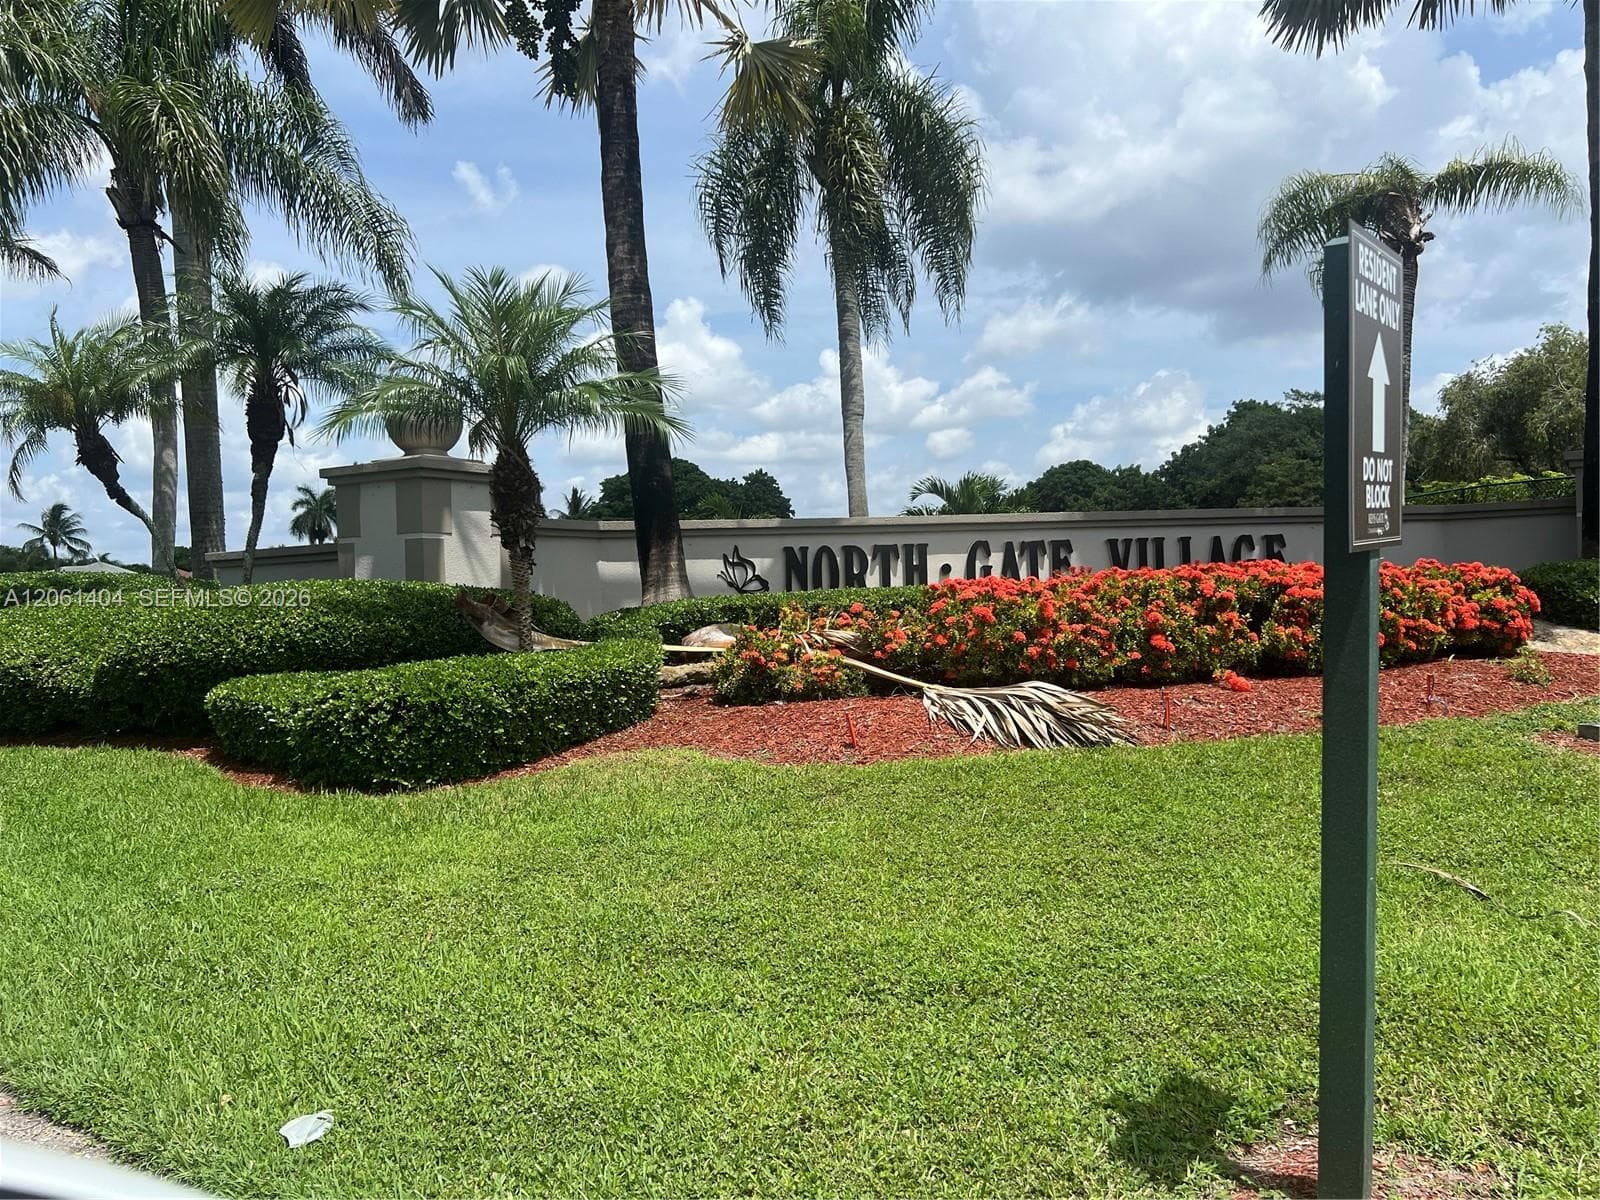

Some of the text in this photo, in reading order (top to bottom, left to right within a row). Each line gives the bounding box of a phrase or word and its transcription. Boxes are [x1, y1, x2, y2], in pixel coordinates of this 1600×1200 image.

[1359, 242, 1397, 296] RESIDENT
[1356, 278, 1401, 331] LANE ONLY
[1363, 457, 1393, 482] DO NOT
[1366, 484, 1391, 508] BLOCK
[783, 543, 929, 592] NORTH
[966, 540, 1074, 581] GATE
